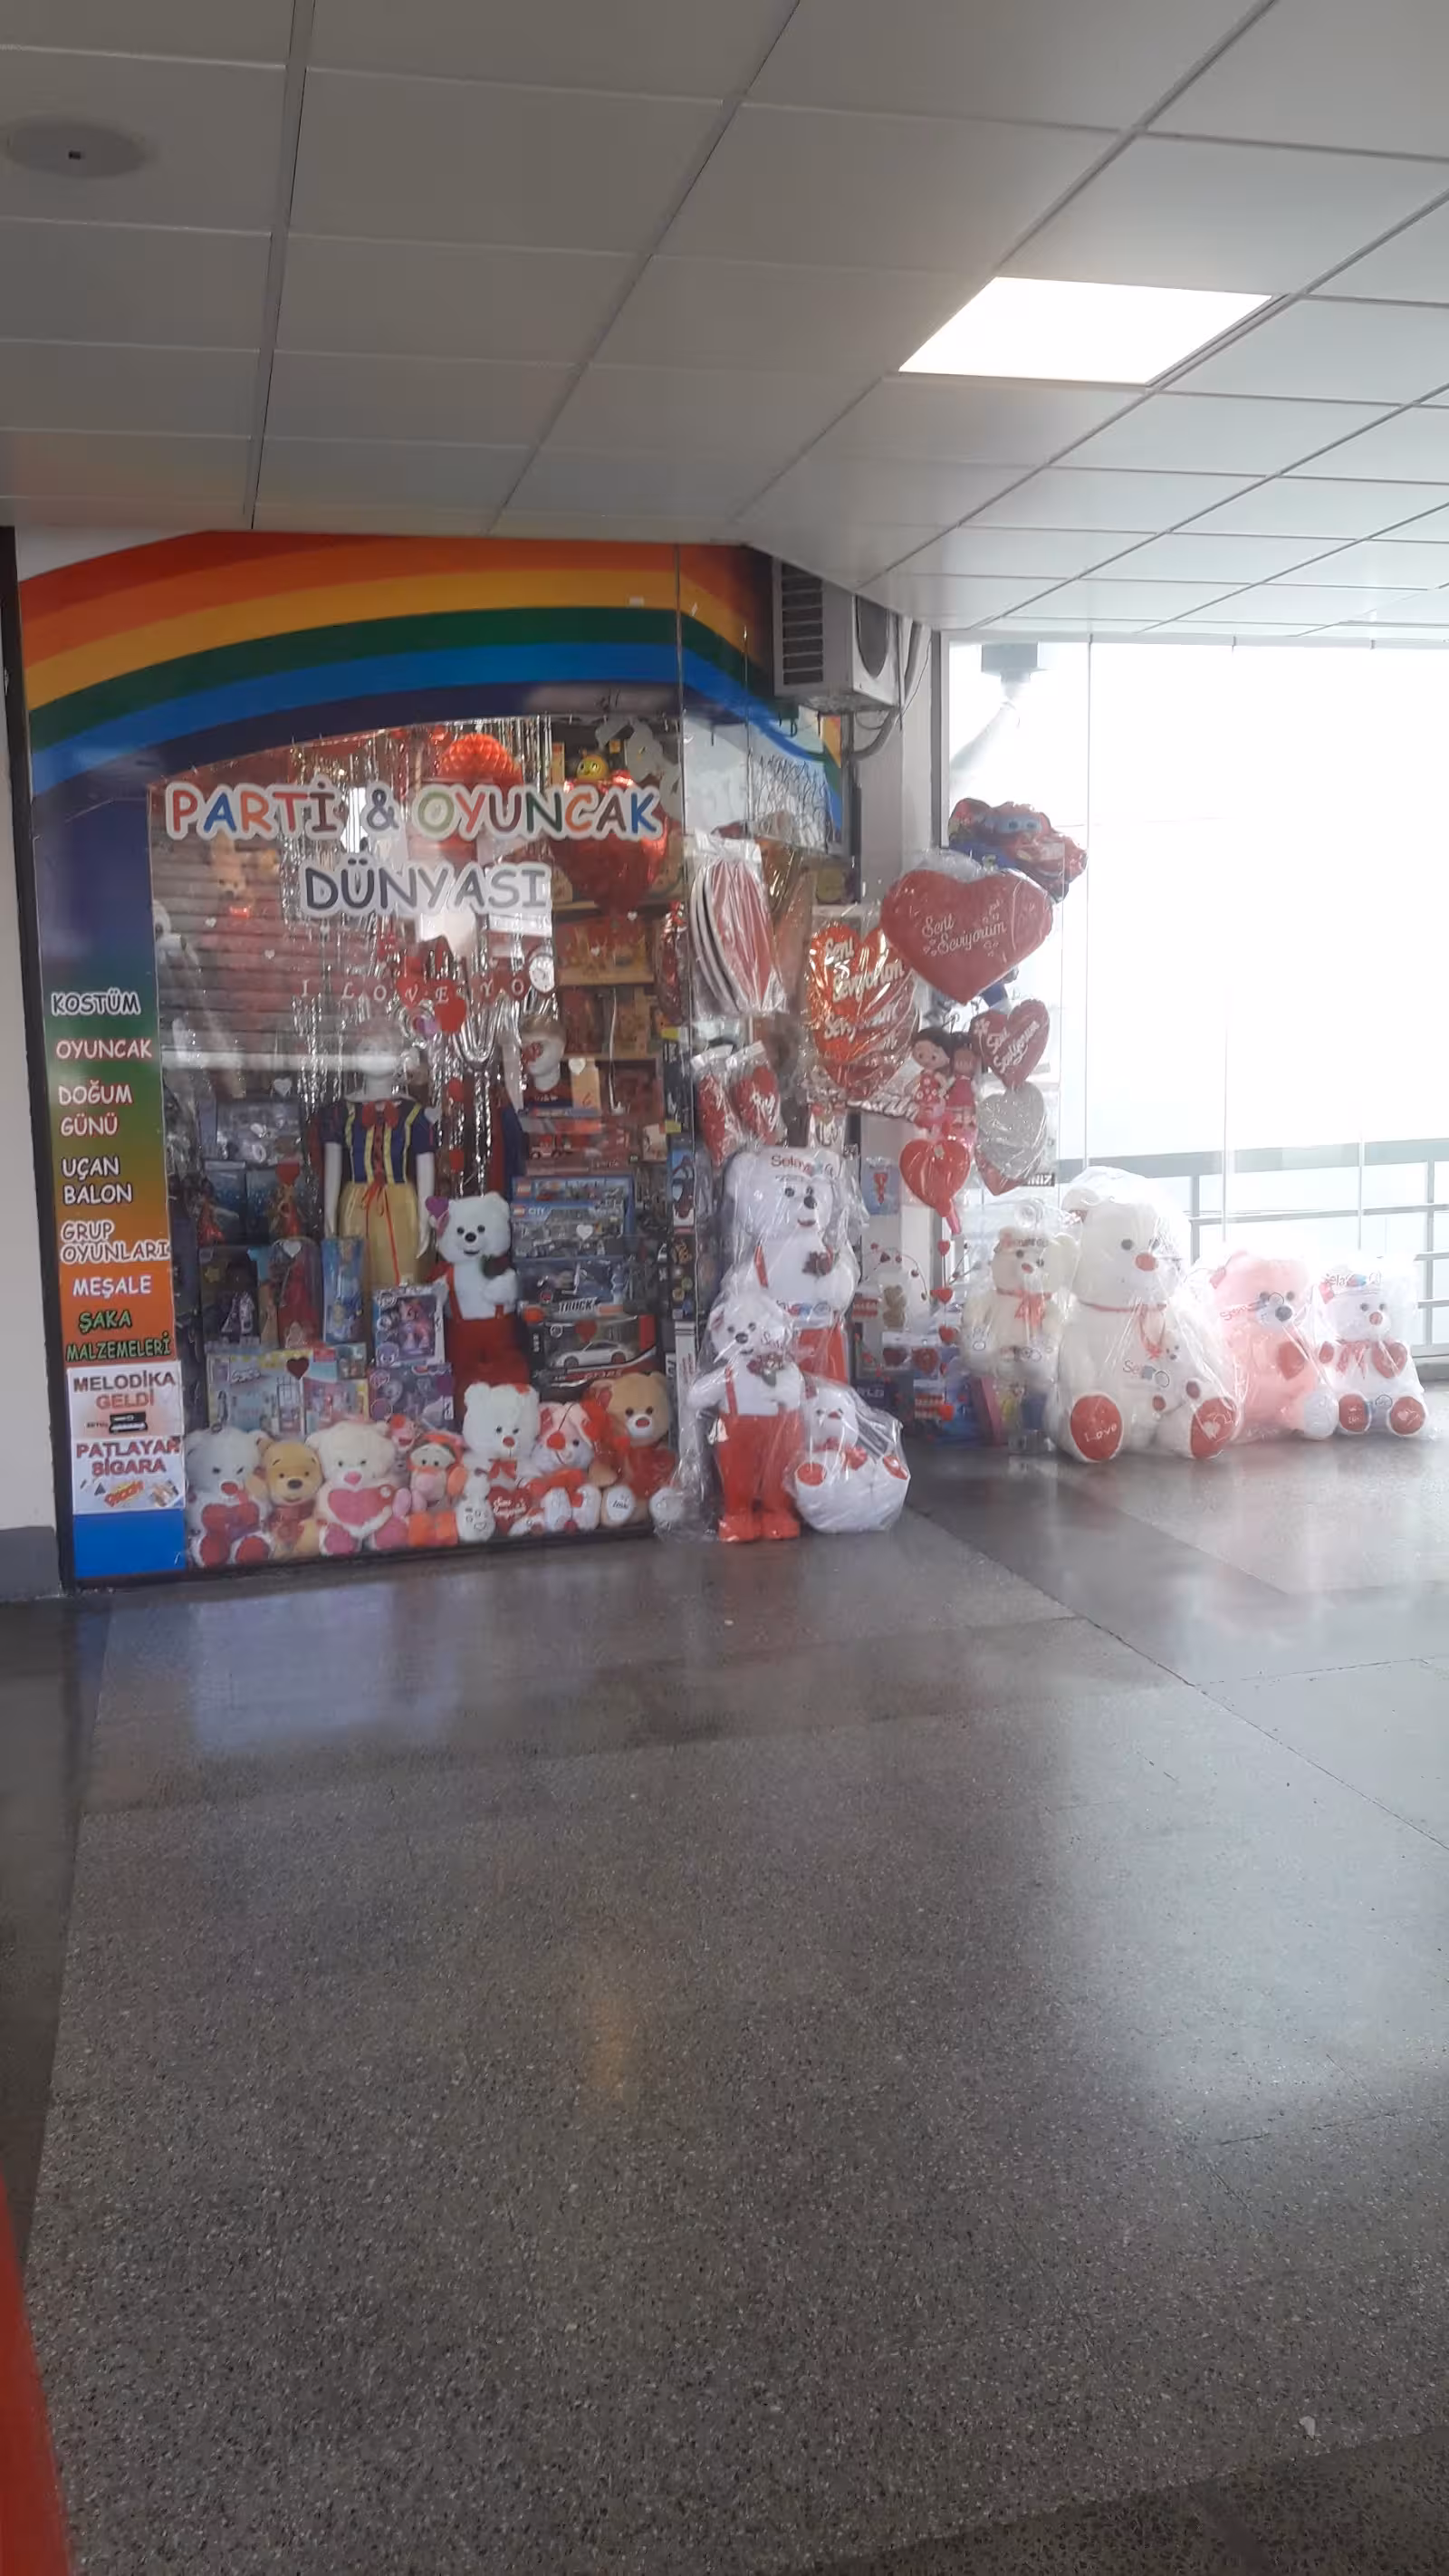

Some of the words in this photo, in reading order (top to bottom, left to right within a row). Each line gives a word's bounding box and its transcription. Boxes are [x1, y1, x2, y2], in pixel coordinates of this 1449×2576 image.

[168, 779, 344, 839] PARTİ
[364, 786, 399, 831] &
[416, 786, 663, 839] OYUNCAK
[303, 856, 550, 913] DÜNYASI
[921, 912, 955, 937] Seni
[936, 920, 1008, 955] Seviyorum
[480, 978, 525, 997] YO
[51, 988, 141, 1015] KOSTÜM
[56, 1038, 153, 1060] OYUNCAK
[58, 1081, 133, 1106] DOĞUM
[60, 1112, 119, 1138] GÜNÜ
[62, 1157, 120, 1179] UÇAN
[62, 1184, 133, 1206] BALON
[61, 1220, 116, 1242] GRUP
[60, 1238, 171, 1264] OYUNLARI
[72, 1274, 153, 1300] MEŞALE
[78, 1309, 133, 1335] ŞAKA
[65, 1331, 172, 1362] MALZEMELERİ
[73, 1370, 176, 1393] MELODİKA
[95, 1389, 155, 1410] GELDİ
